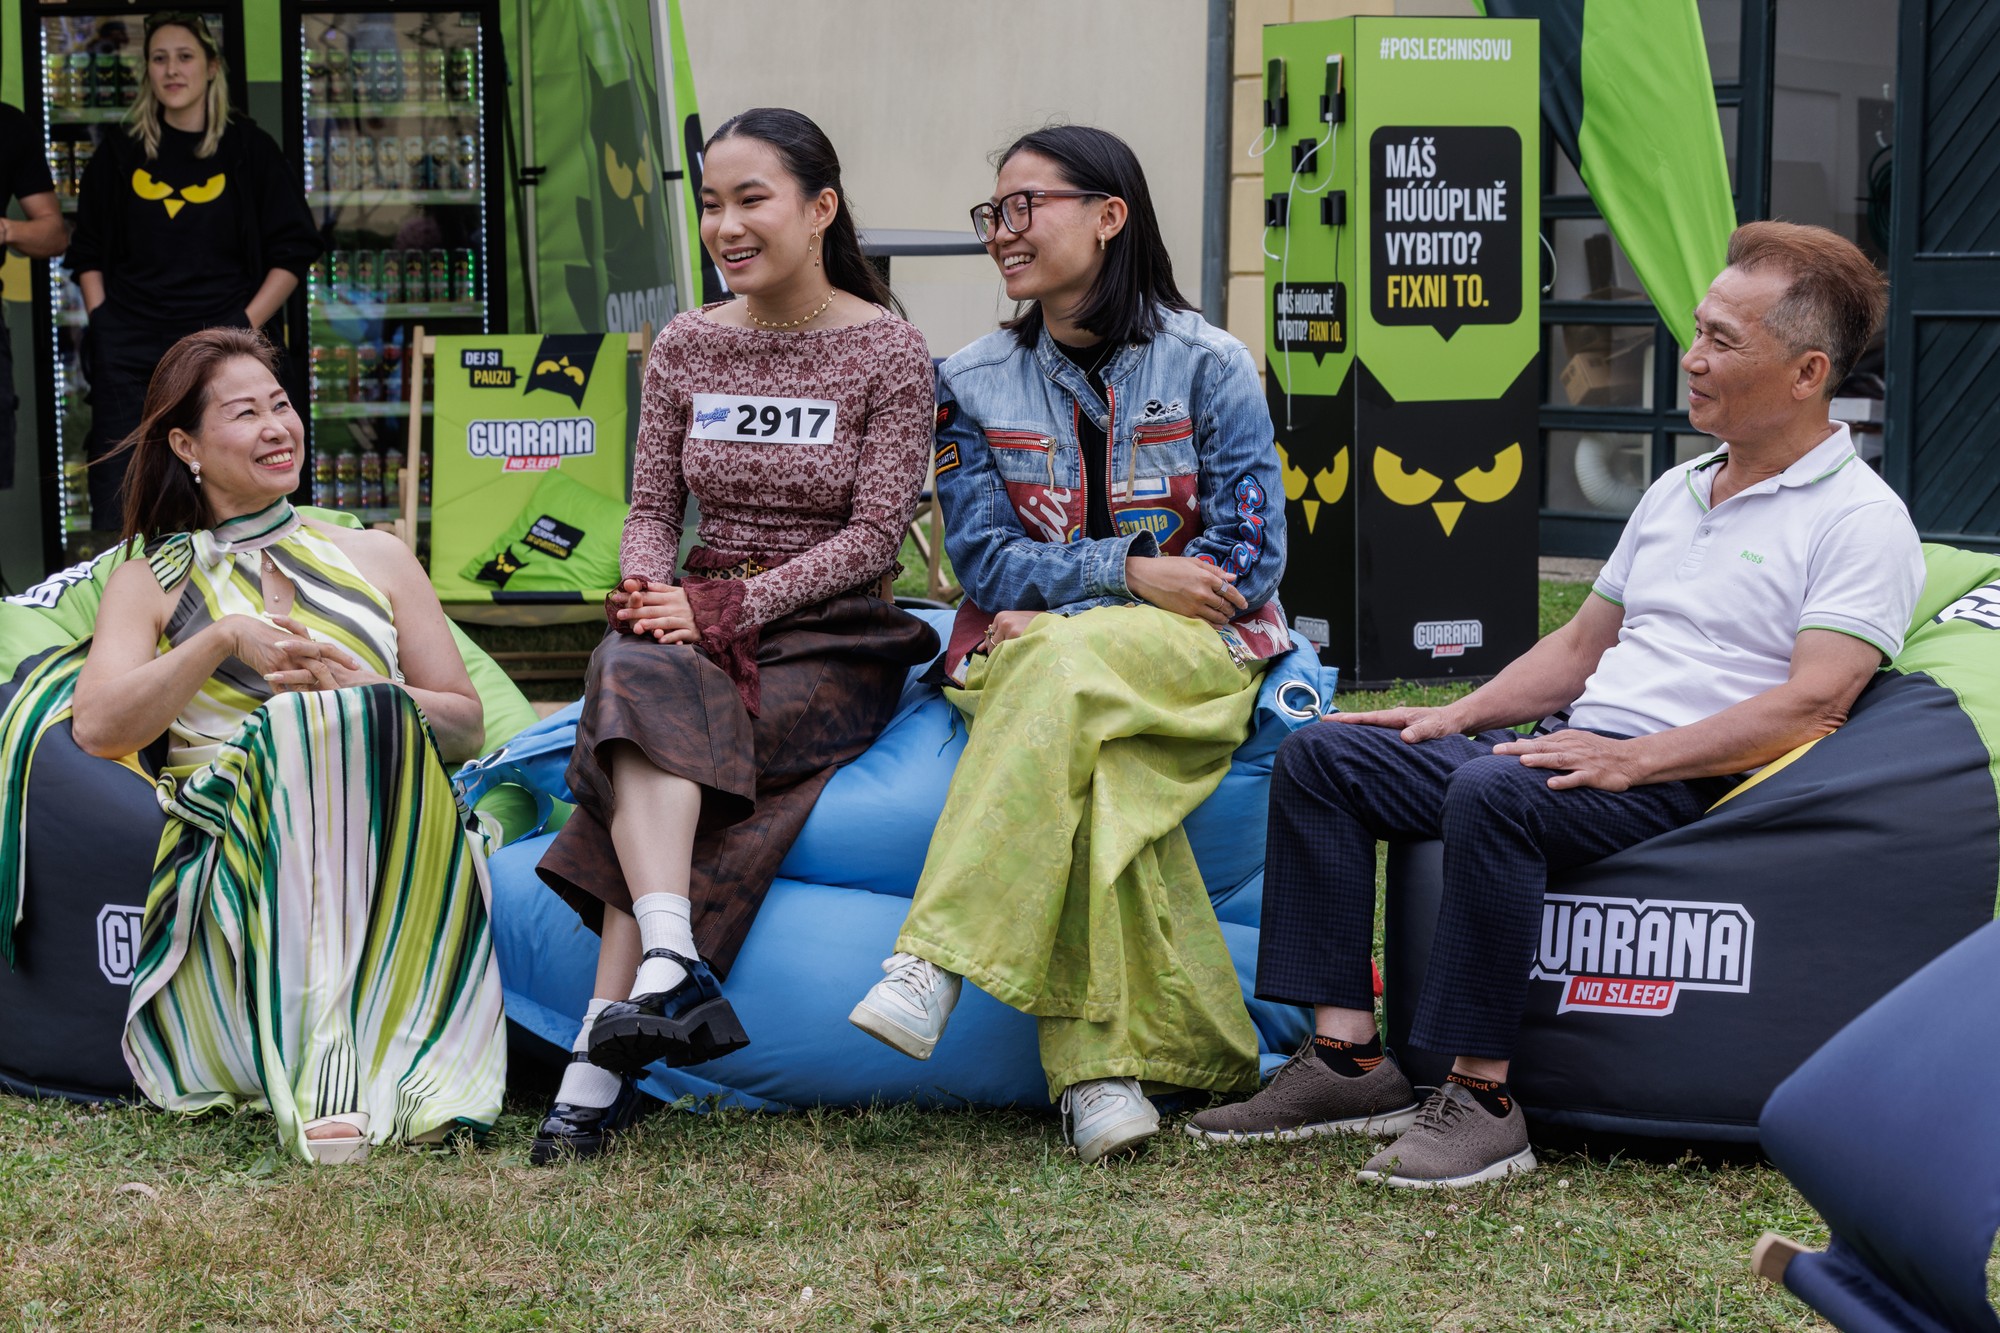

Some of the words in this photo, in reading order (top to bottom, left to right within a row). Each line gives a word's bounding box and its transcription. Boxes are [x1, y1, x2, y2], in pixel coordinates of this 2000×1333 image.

[1380, 38, 1512, 61] #POSLECHNISOVU
[1385, 136, 1436, 178] MÁŠ
[1385, 180, 1507, 222] HÚÚÚPLNĚ
[1385, 232, 1482, 266] VYBITO?
[1387, 275, 1447, 308] FIXNI
[1453, 274, 1489, 307] TO.
[1309, 321, 1329, 341] FIXNI
[465, 352, 485, 366] DEJ
[487, 351, 499, 365] SI
[474, 370, 511, 385] PAUZU
[736, 404, 830, 438] 2917
[469, 418, 594, 457] GUARANA
[509, 457, 525, 469] NO
[526, 456, 558, 469] SLEEP
[1119, 514, 1169, 536] anilla
[1416, 621, 1481, 647] GUARANA
[1534, 900, 1748, 984] UARANA
[1575, 981, 1603, 1001] NO
[1604, 983, 1670, 1006] SLEEP
